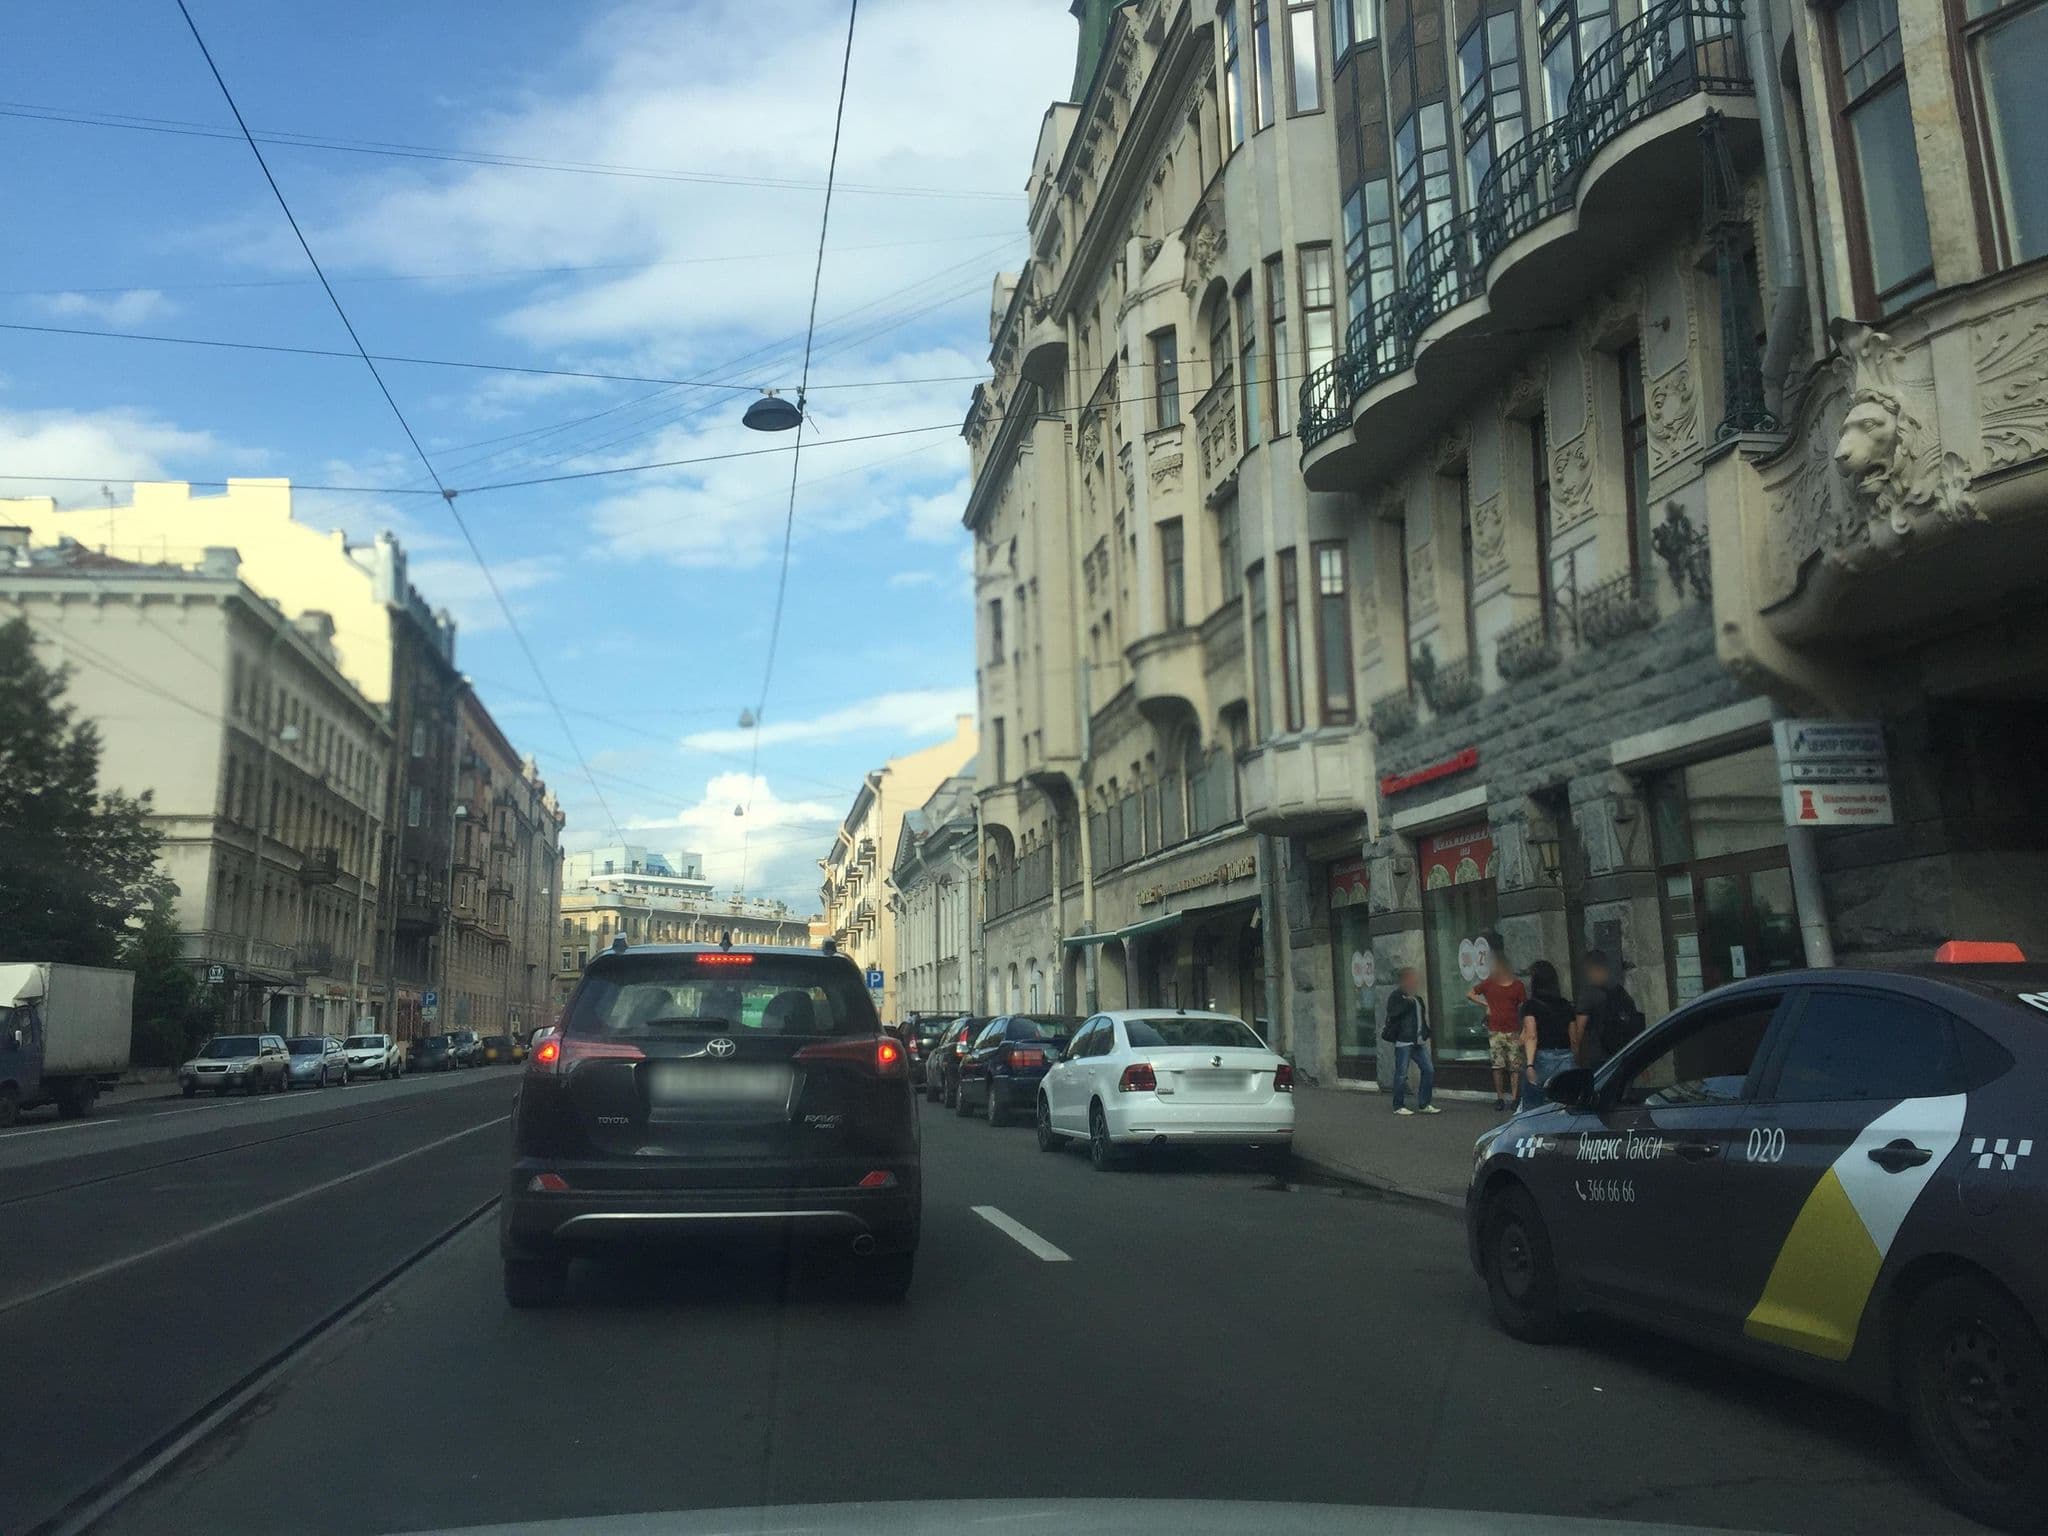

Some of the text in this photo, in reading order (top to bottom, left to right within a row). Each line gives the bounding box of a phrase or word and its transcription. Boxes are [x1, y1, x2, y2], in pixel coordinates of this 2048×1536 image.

[870, 972, 881, 987] P
[425, 993, 435, 1005] P
[597, 1116, 630, 1125] TOYOTA
[1576, 1128, 1663, 1163] Яндекс Такси
[1746, 1127, 1786, 1163] 020
[1588, 1179, 1636, 1202] 366 66 66
